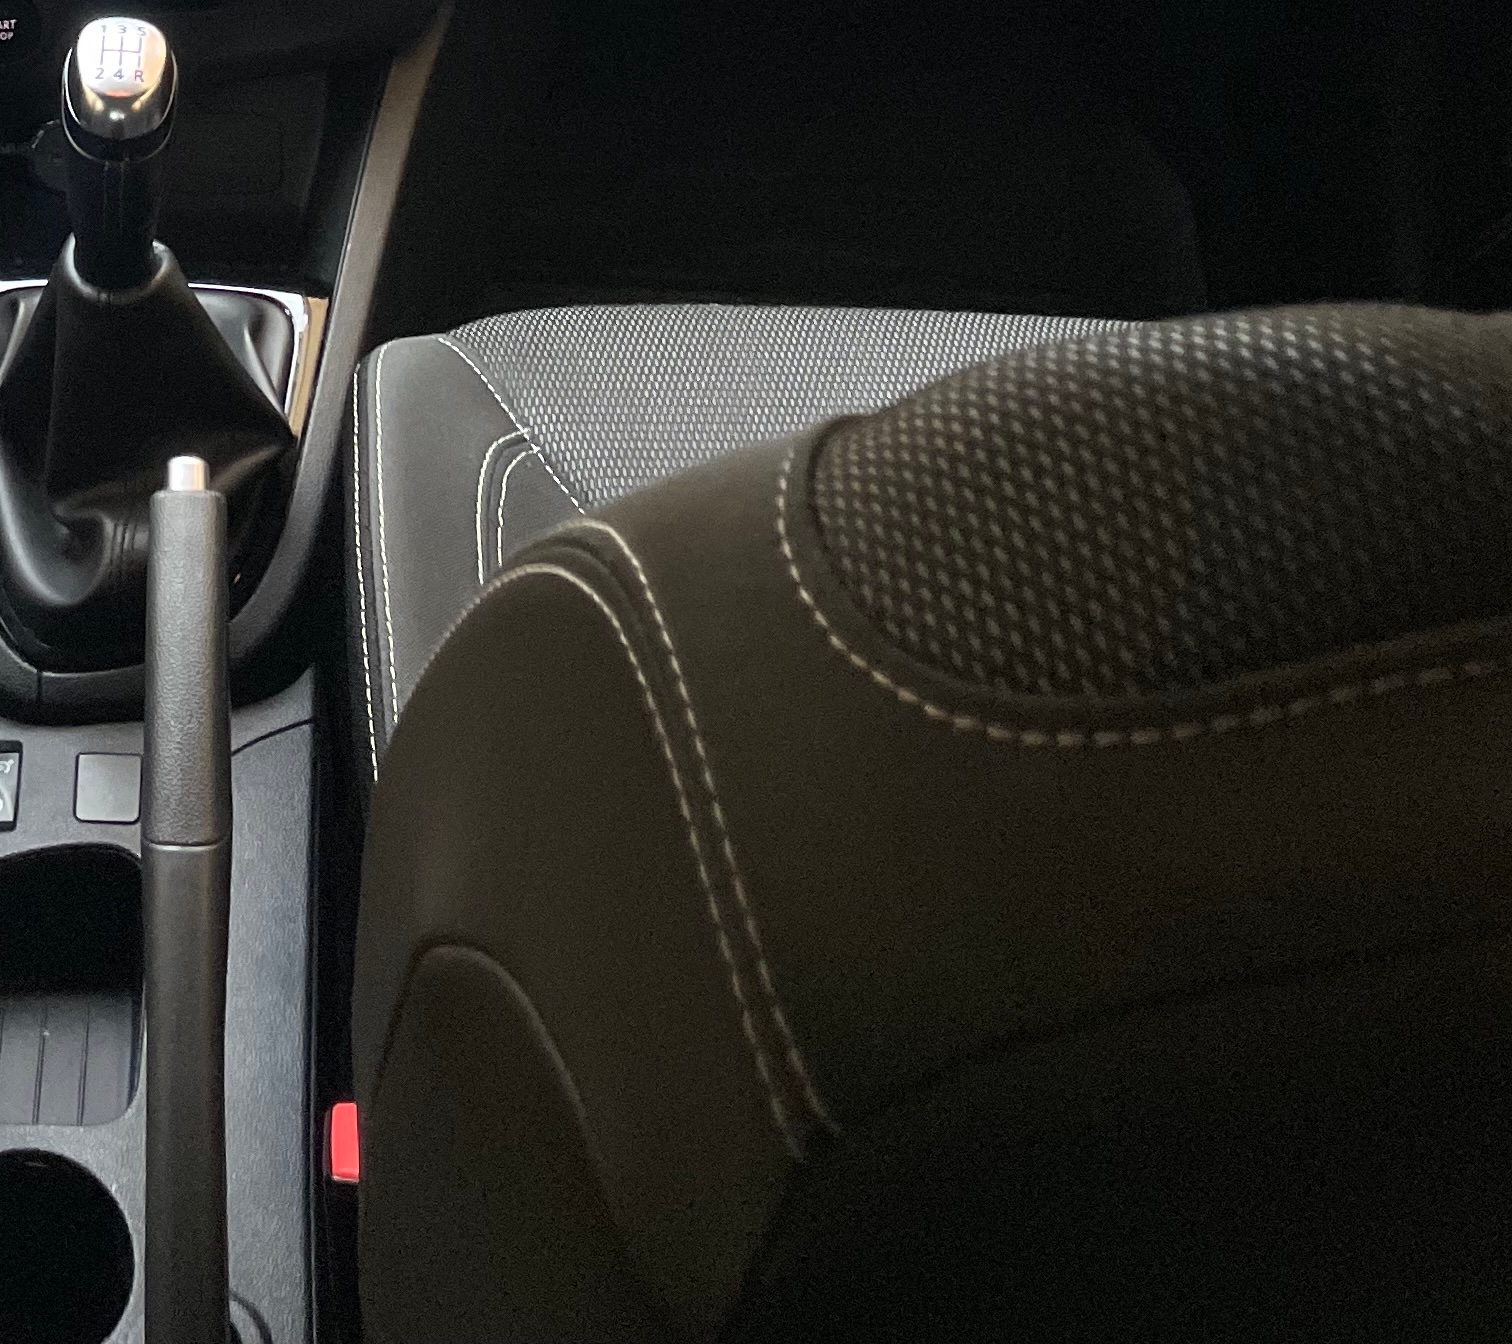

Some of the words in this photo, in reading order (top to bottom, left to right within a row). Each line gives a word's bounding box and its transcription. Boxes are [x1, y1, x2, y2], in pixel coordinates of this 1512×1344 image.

[136, 26, 147, 37] 5
[94, 67, 105, 80] 2
[113, 67, 125, 80] 4
[134, 69, 145, 83] R
